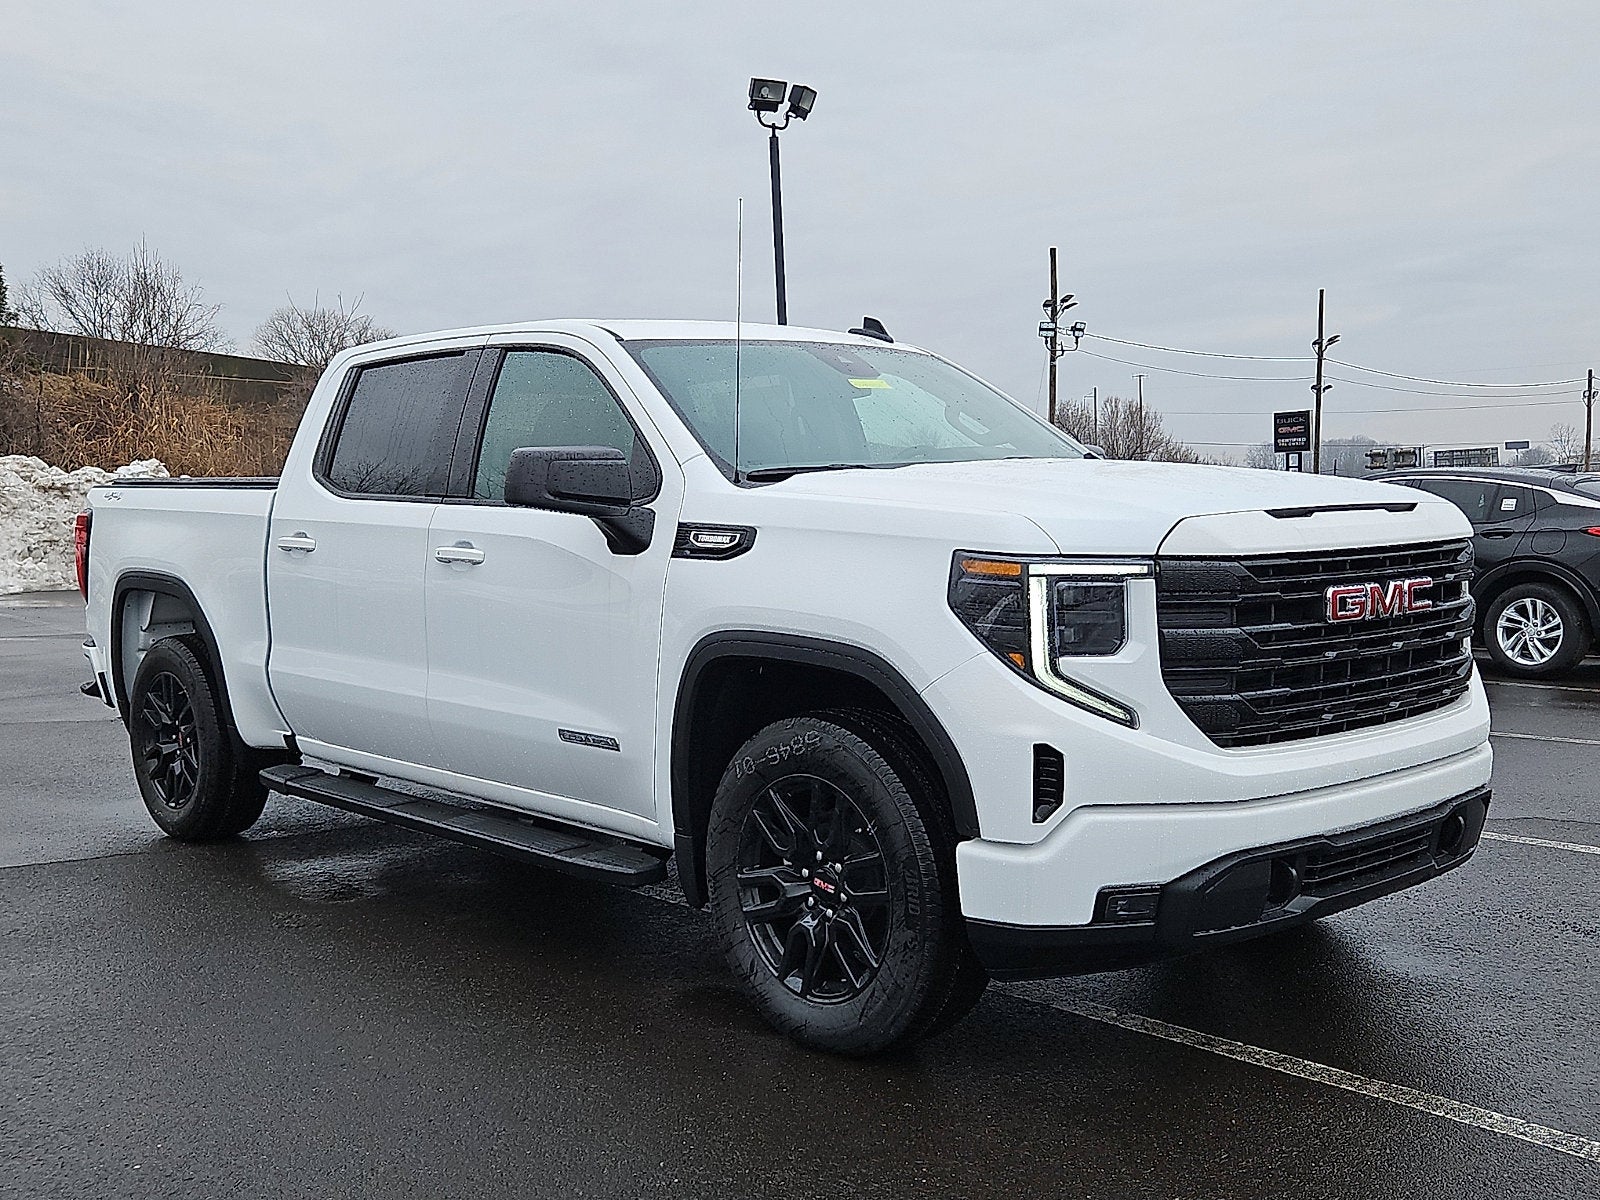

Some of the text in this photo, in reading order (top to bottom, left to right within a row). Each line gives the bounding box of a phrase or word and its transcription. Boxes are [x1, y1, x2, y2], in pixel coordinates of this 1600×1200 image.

[1277, 425, 1305, 433] GMC
[1326, 577, 1434, 623] GMC
[813, 876, 836, 894] GMC
